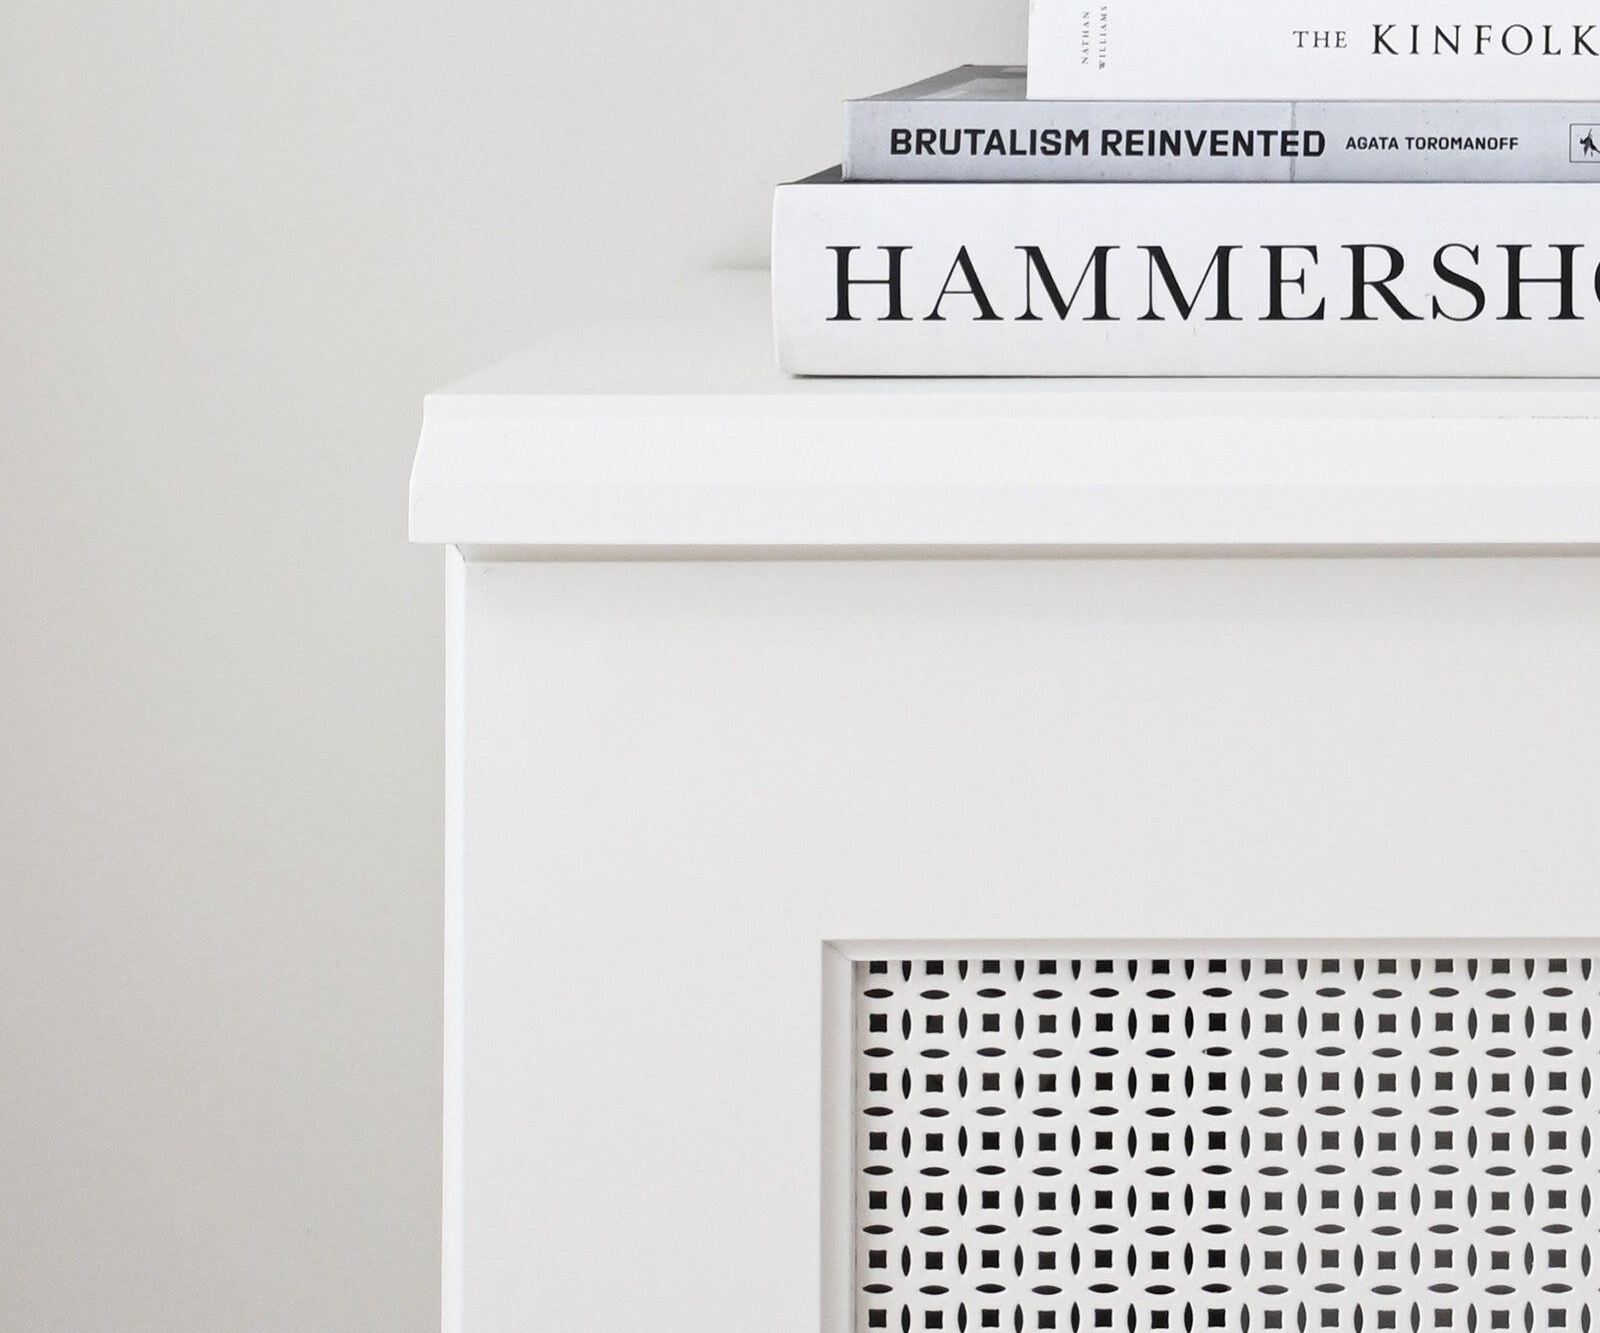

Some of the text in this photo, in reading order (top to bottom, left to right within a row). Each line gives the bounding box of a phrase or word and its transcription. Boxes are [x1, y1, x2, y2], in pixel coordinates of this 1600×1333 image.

[1081, 11, 1090, 65] NATHAN
[1098, 5, 1108, 70] WILLIAMS
[1292, 30, 1348, 49] THE
[1372, 23, 1600, 57] KINFOLK
[890, 128, 1326, 158] BRUTALISM REINVENTED
[1345, 136, 1519, 151] AGATA TOROMANOFF
